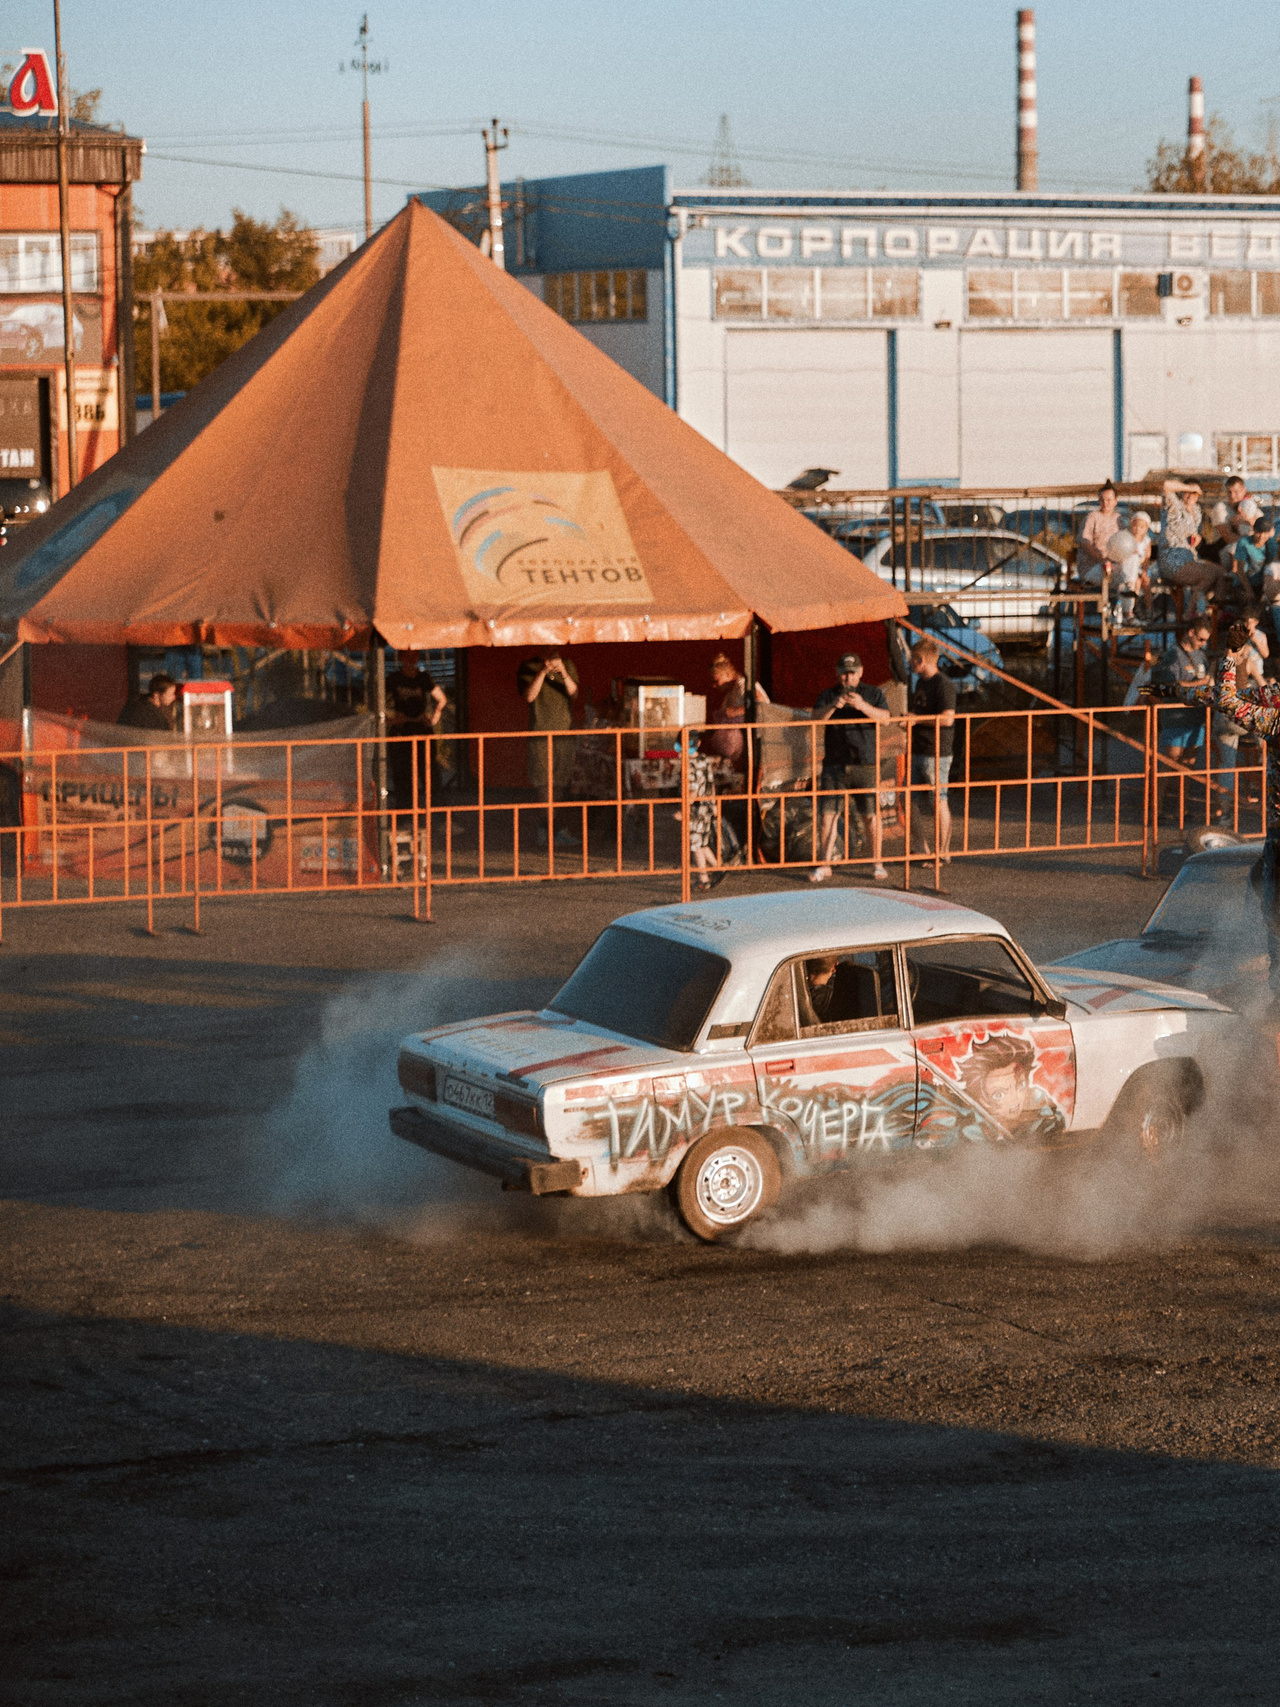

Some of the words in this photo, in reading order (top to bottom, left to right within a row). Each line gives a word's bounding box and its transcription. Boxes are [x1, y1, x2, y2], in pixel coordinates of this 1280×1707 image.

[714, 226, 1122, 261] КОРПОРАЦИЯ
[0, 448, 35, 468] ТАЖ
[521, 566, 643, 584] ТЕНТОВ
[758, 1074, 893, 1150] КОЧЕРГА
